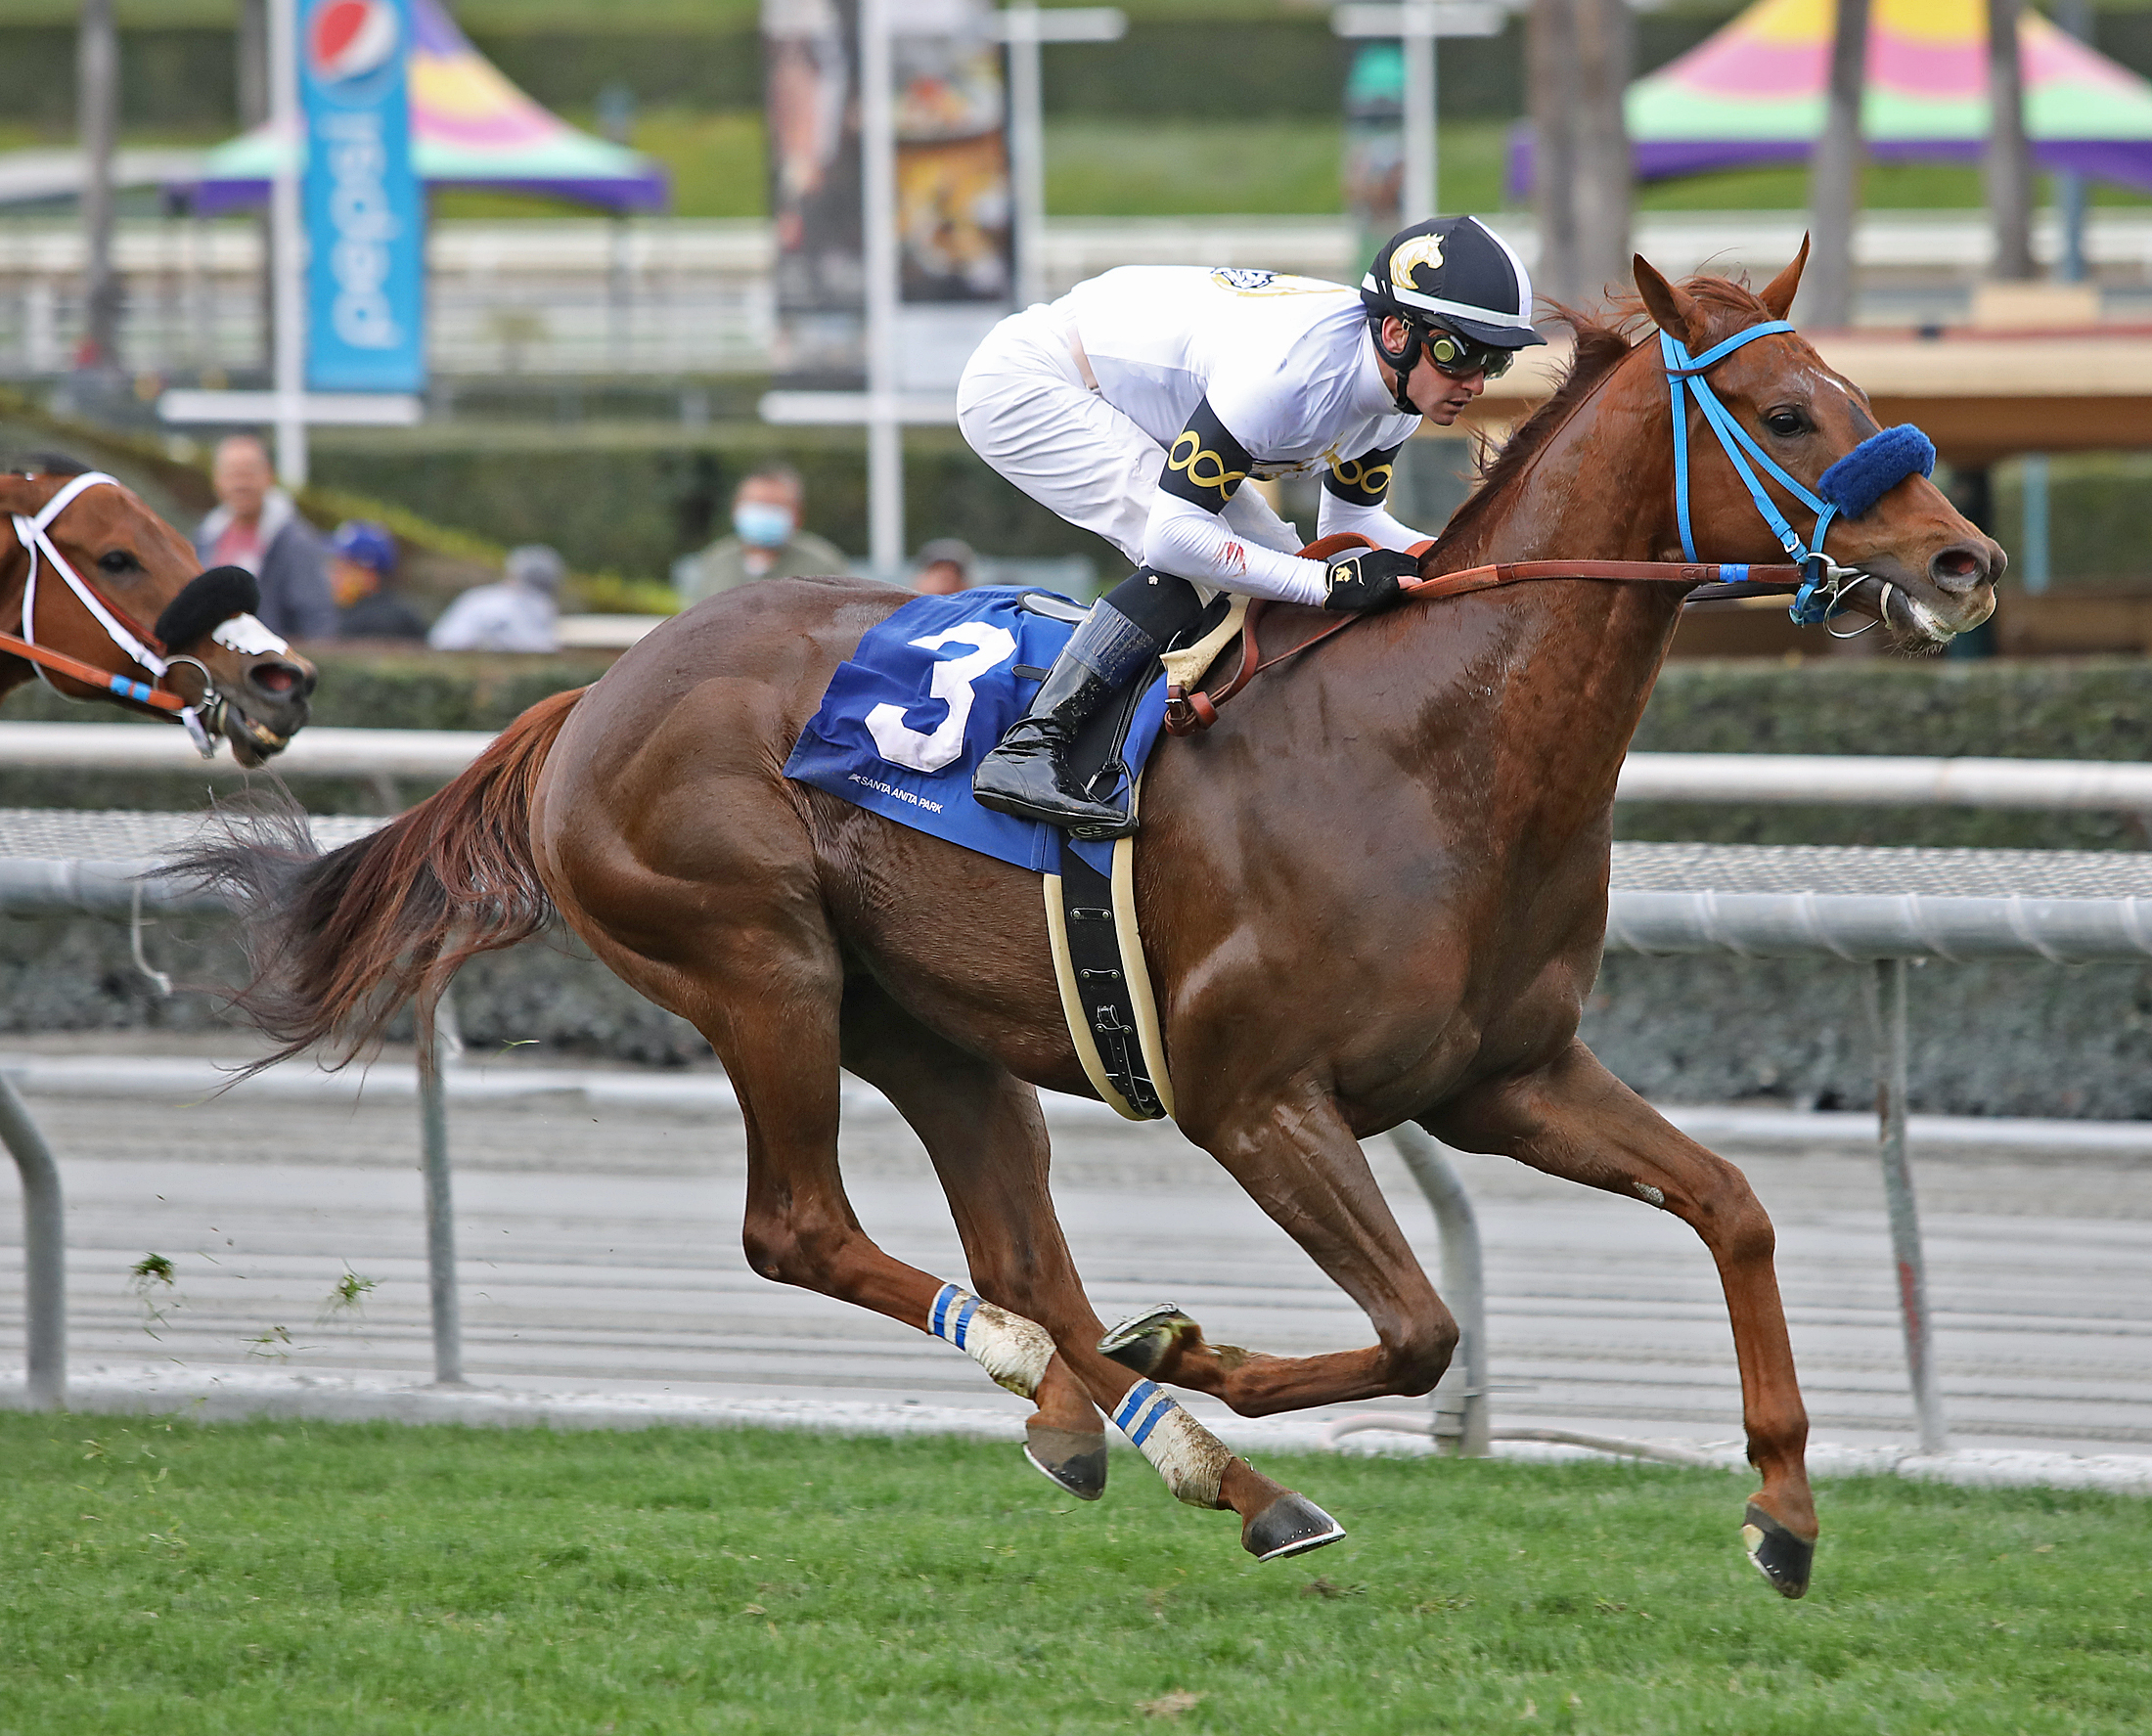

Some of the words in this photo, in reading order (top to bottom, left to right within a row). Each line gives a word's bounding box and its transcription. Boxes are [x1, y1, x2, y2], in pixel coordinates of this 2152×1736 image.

[316, 110, 402, 349] pepsi
[864, 621, 1017, 773] 3
[860, 776, 891, 794] SANTA
[890, 787, 919, 806] ANITA
[918, 797, 943, 814] PARK
